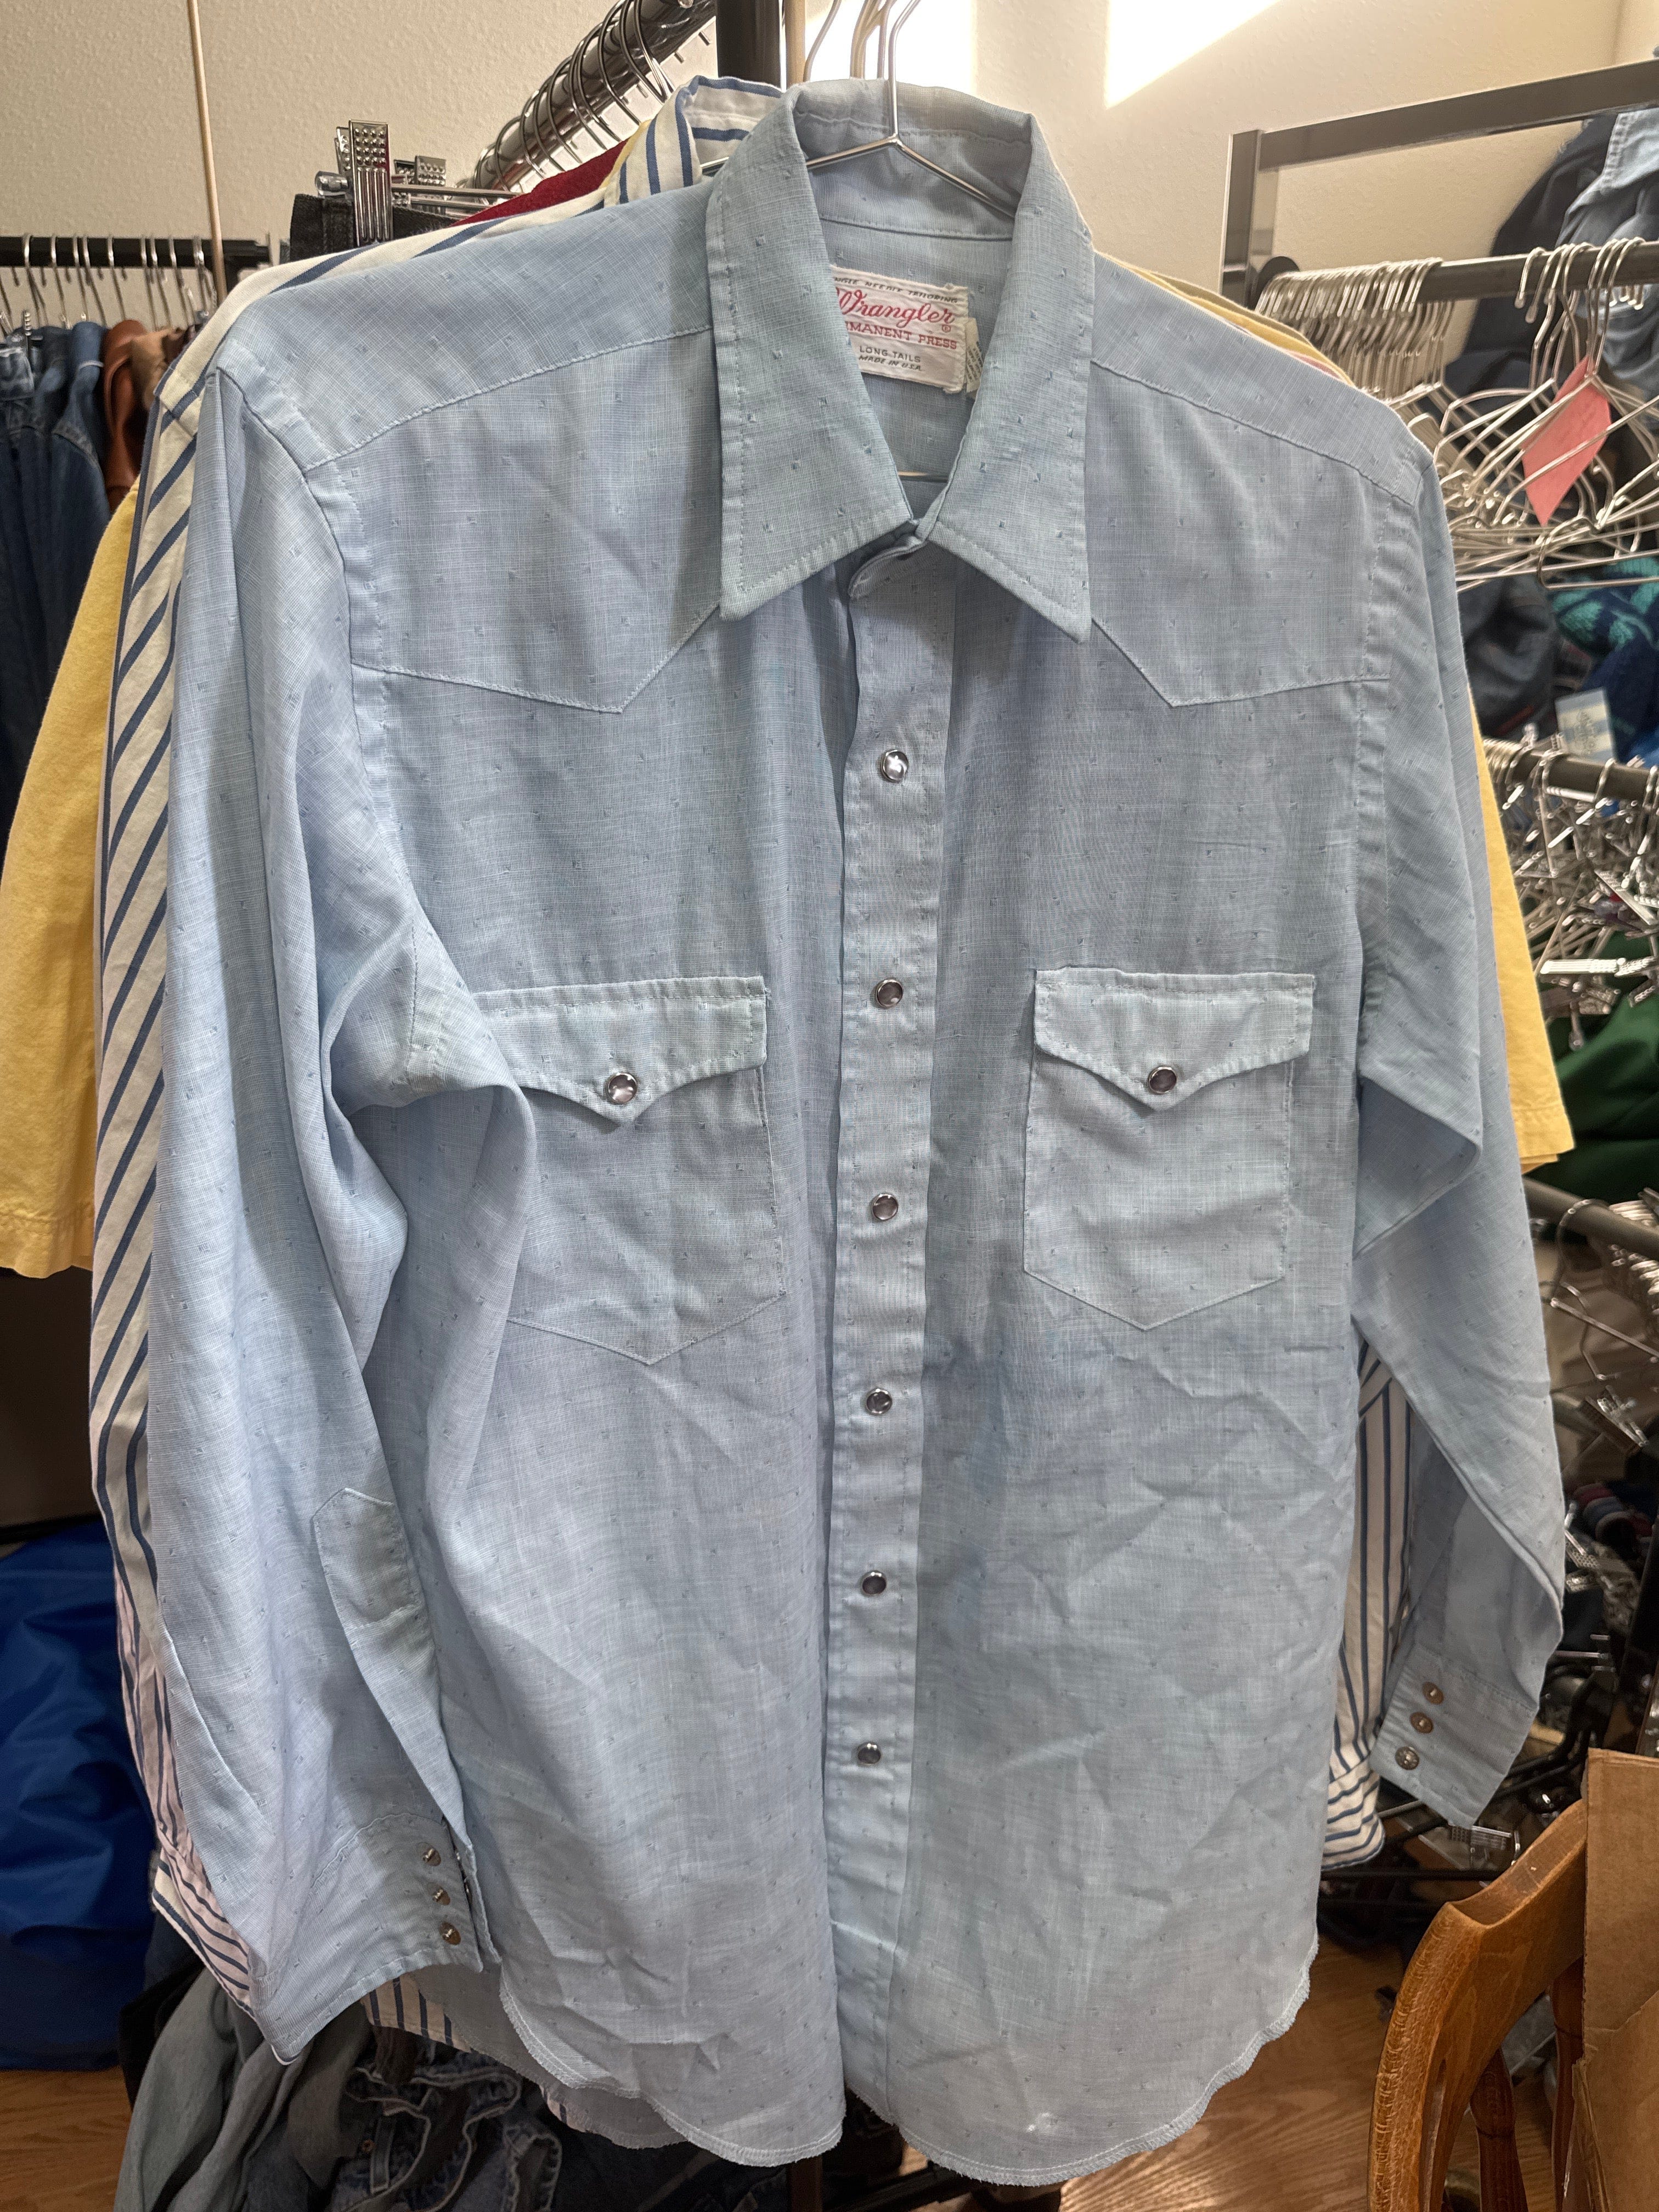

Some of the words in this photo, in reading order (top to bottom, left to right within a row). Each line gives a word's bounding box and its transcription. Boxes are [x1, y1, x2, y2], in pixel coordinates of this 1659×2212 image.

[836, 286, 955, 329] Wrangler
[918, 334, 957, 349] PRESS
[859, 355, 886, 365] MADE
[860, 346, 888, 357] LONG
[892, 351, 921, 363] TAILS
